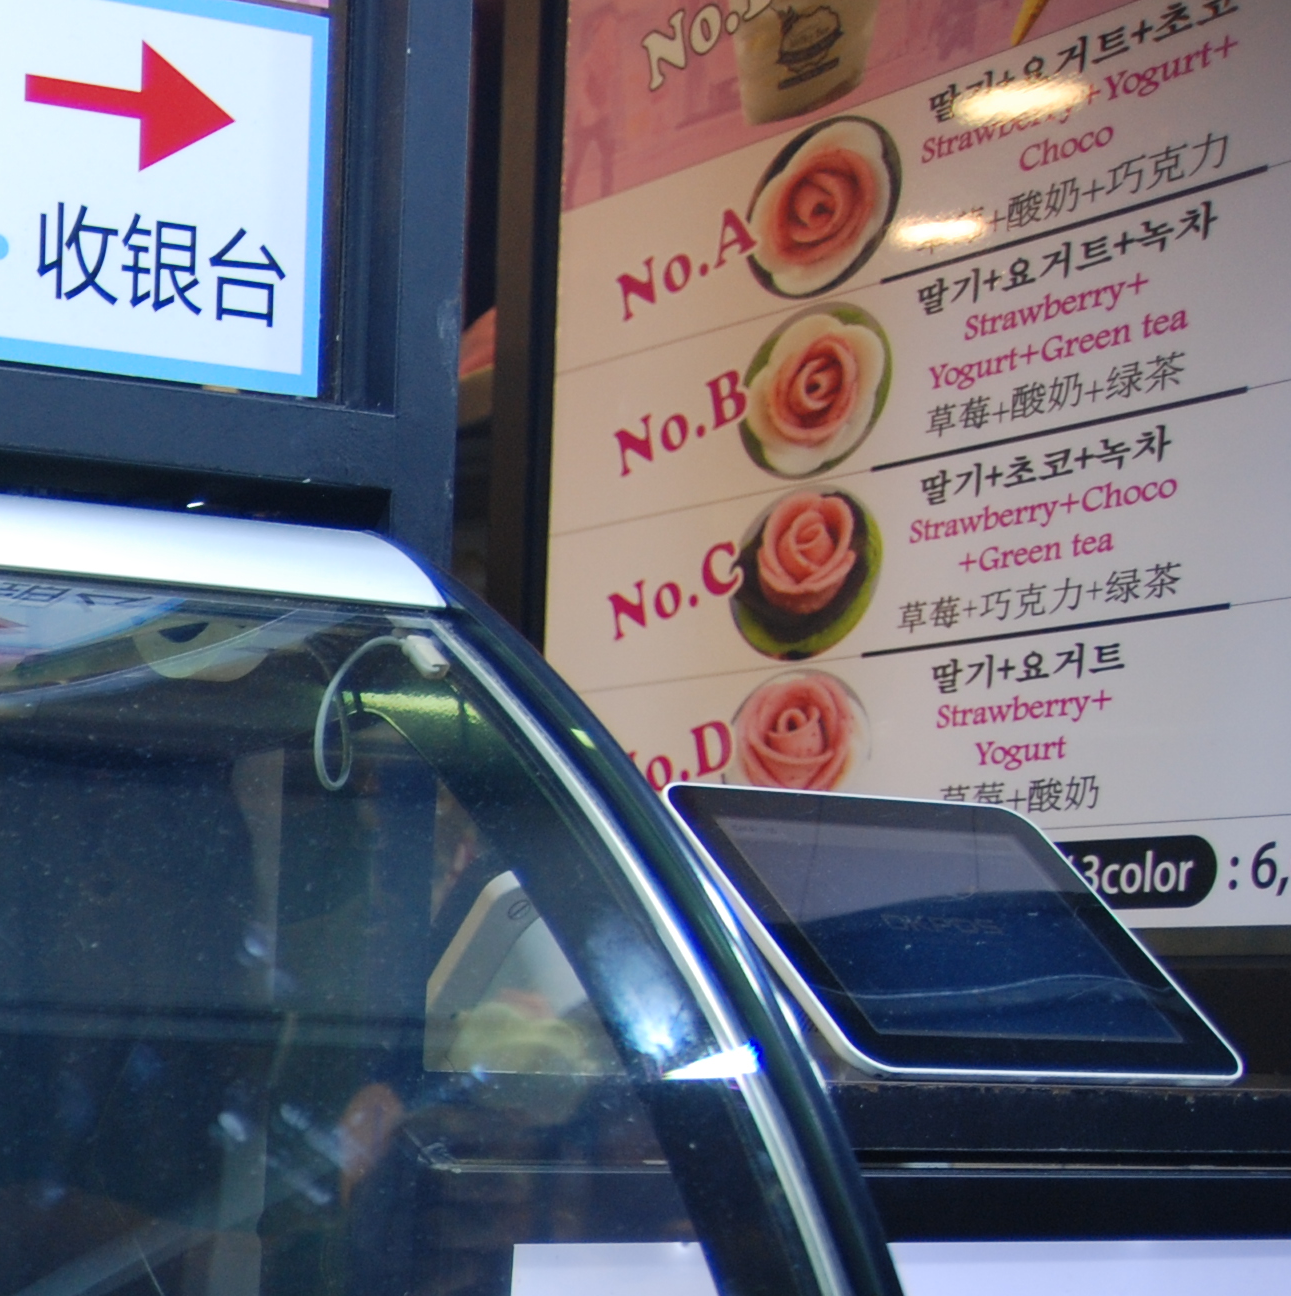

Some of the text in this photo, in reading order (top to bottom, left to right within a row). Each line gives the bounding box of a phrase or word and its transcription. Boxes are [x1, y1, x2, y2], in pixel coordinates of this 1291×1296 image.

[1019, 126, 1114, 171] Choco
[616, 208, 757, 322] No.A
[917, 201, 1218, 317] 딸기+요거트+녹차
[964, 272, 1149, 341] Strawberry+
[929, 308, 1189, 393] Yogurt+Green tea
[613, 369, 747, 478] No.B
[926, 351, 1186, 439] 草莓+酸奶+绿茶
[921, 423, 1172, 507] 딸기+초코+녹차
[908, 477, 1178, 545] Strawberry+Choco
[958, 531, 1113, 573] +Green tea
[607, 540, 742, 641] No.C
[896, 561, 1183, 635] 草莓+巧克力+绿茶
[931, 642, 1125, 695] 딸기+요거트
[936, 690, 1112, 730] Strawberry+
[628, 720, 732, 791] o.D
[975, 735, 1067, 771] Yogurt
[1082, 850, 1194, 894] 3color
